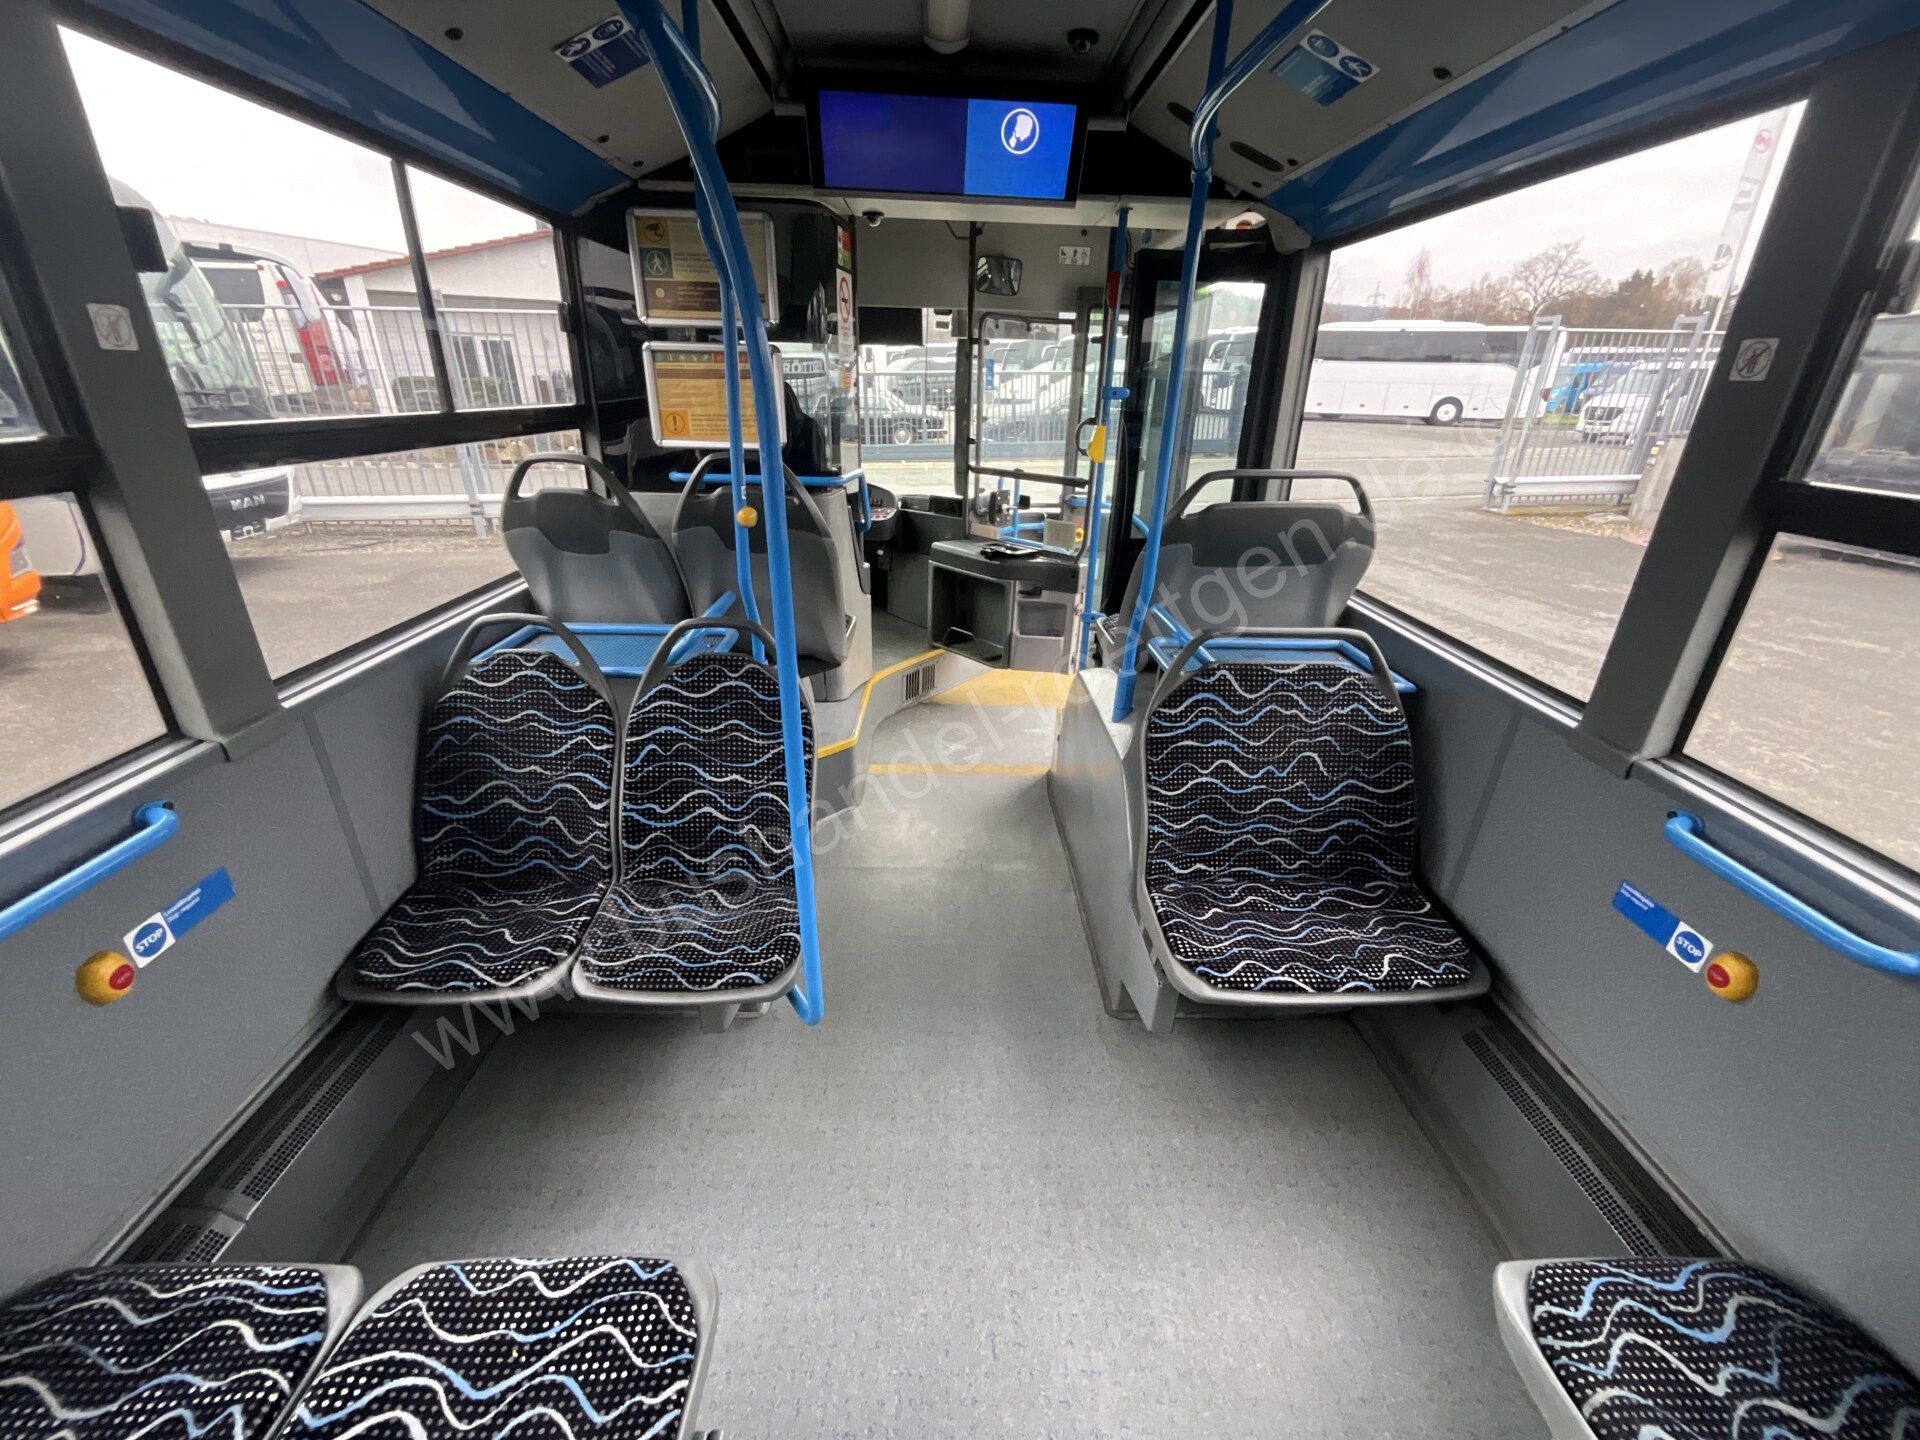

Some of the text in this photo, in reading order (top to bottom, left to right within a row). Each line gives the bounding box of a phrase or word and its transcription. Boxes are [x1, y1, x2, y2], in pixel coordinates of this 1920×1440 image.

[229, 494, 266, 511] MAN
[135, 927, 164, 953] STOP
[1675, 935, 1703, 957] STOP
